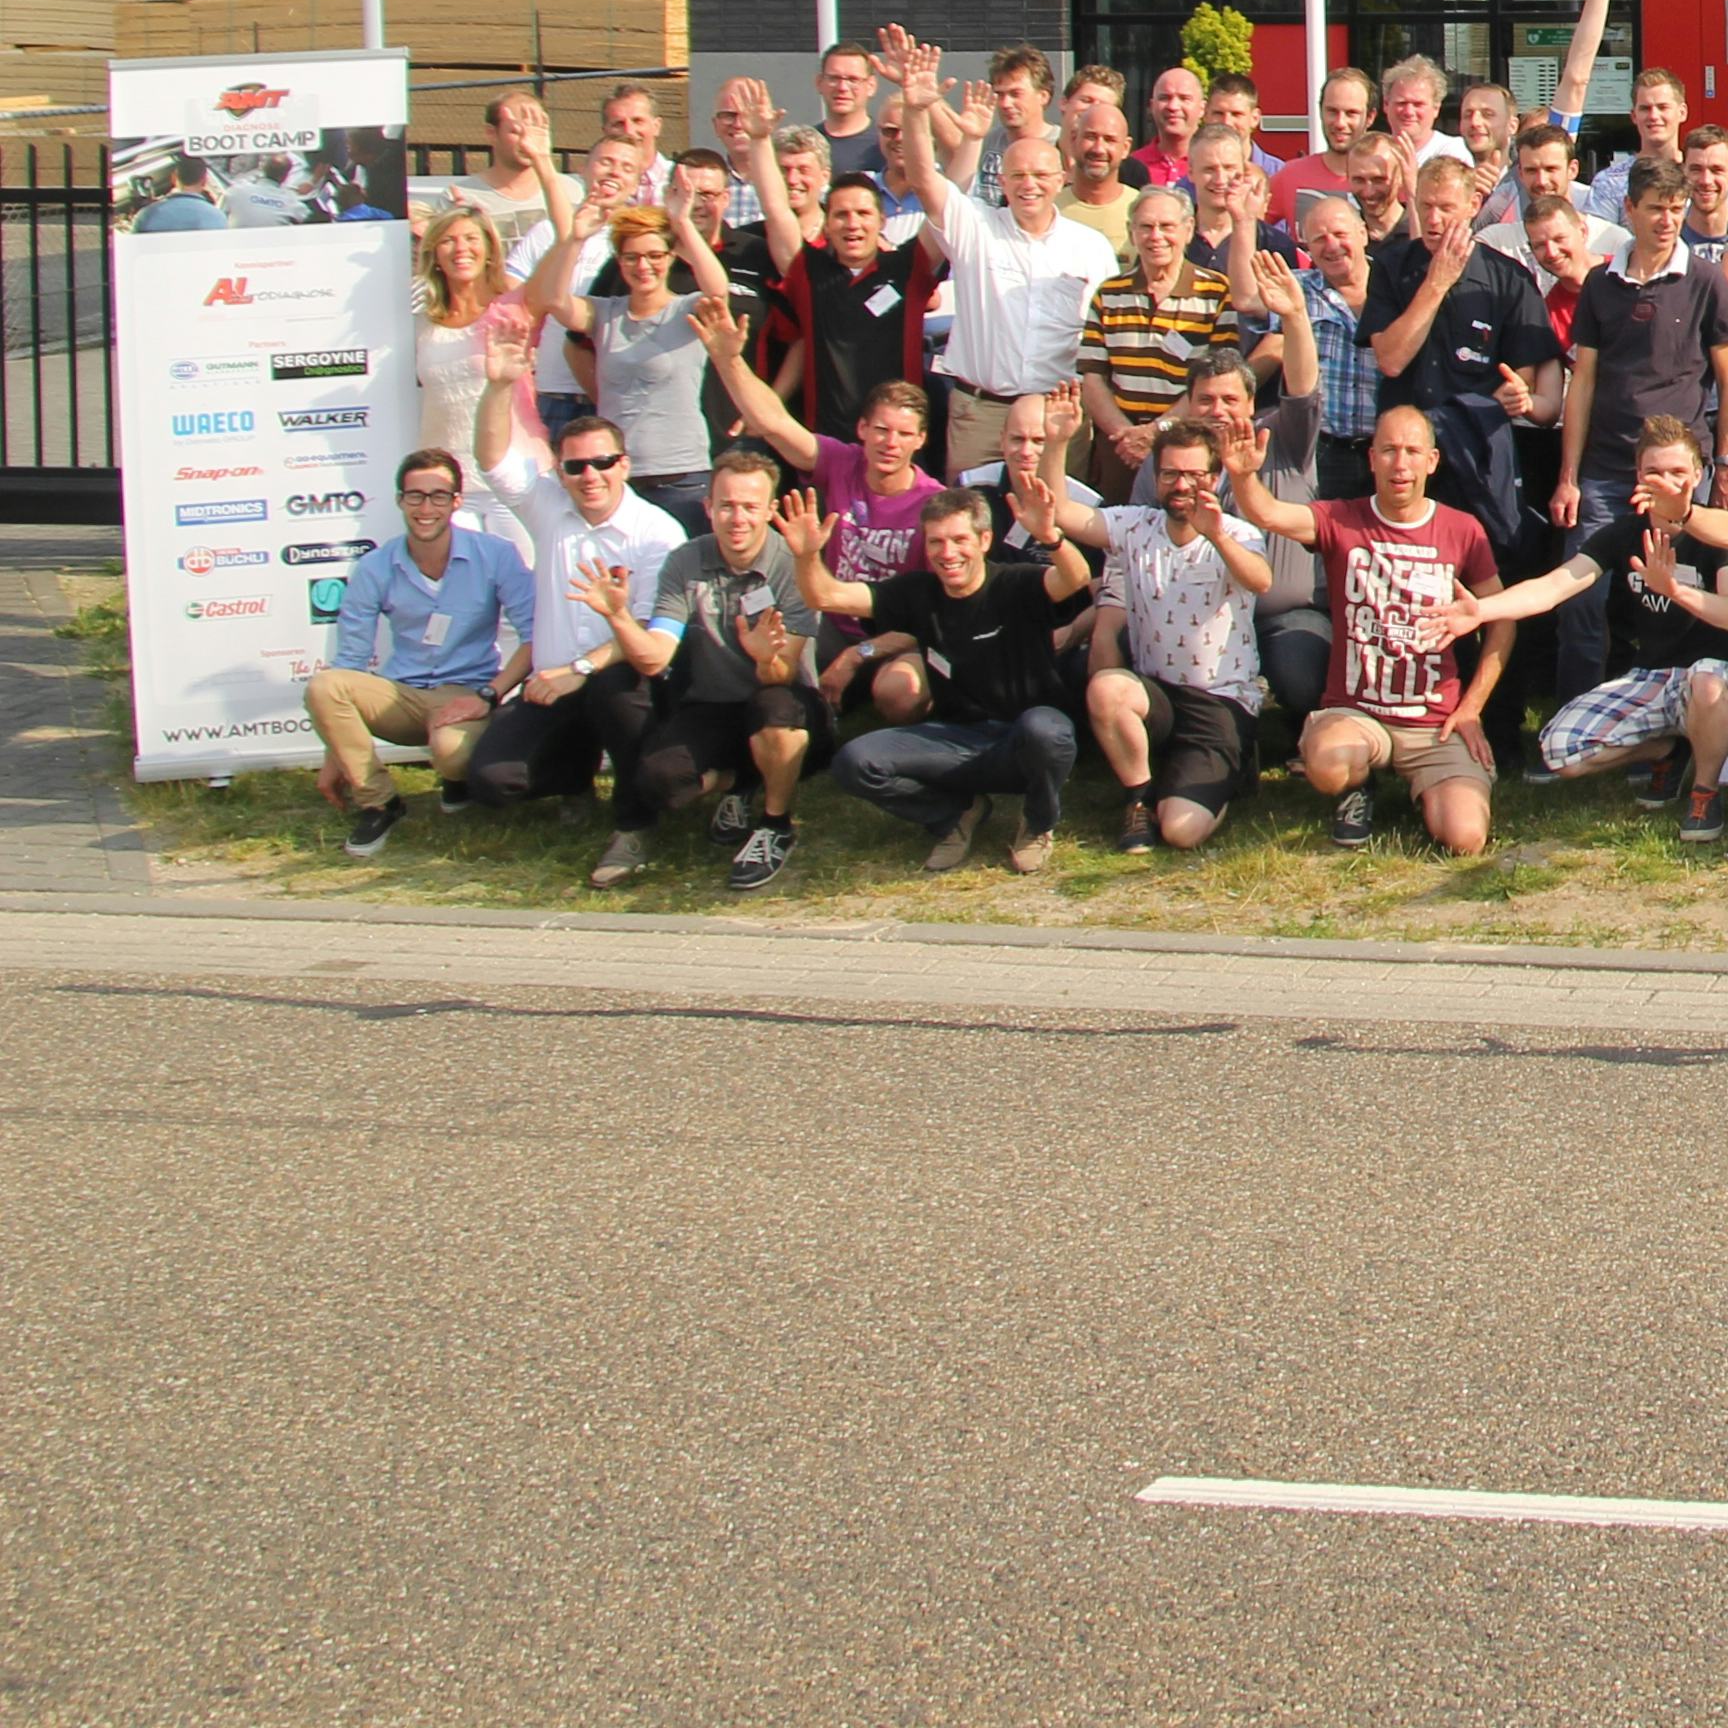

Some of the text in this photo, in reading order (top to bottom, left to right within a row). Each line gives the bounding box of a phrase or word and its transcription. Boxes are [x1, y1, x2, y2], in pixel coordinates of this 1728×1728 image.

[222, 122, 281, 132] DIAGNOSE
[187, 130, 316, 152] BOOT CAMP
[273, 350, 366, 369] SERGOYNE
[171, 410, 255, 436] WAECO
[277, 411, 369, 428] WALKER
[179, 502, 264, 518] MIDTRONICS
[286, 490, 366, 515] GMTO
[205, 597, 266, 618] Castrol
[1345, 638, 1443, 704] VILLE
[163, 718, 314, 743] WWW.AMTBOO
